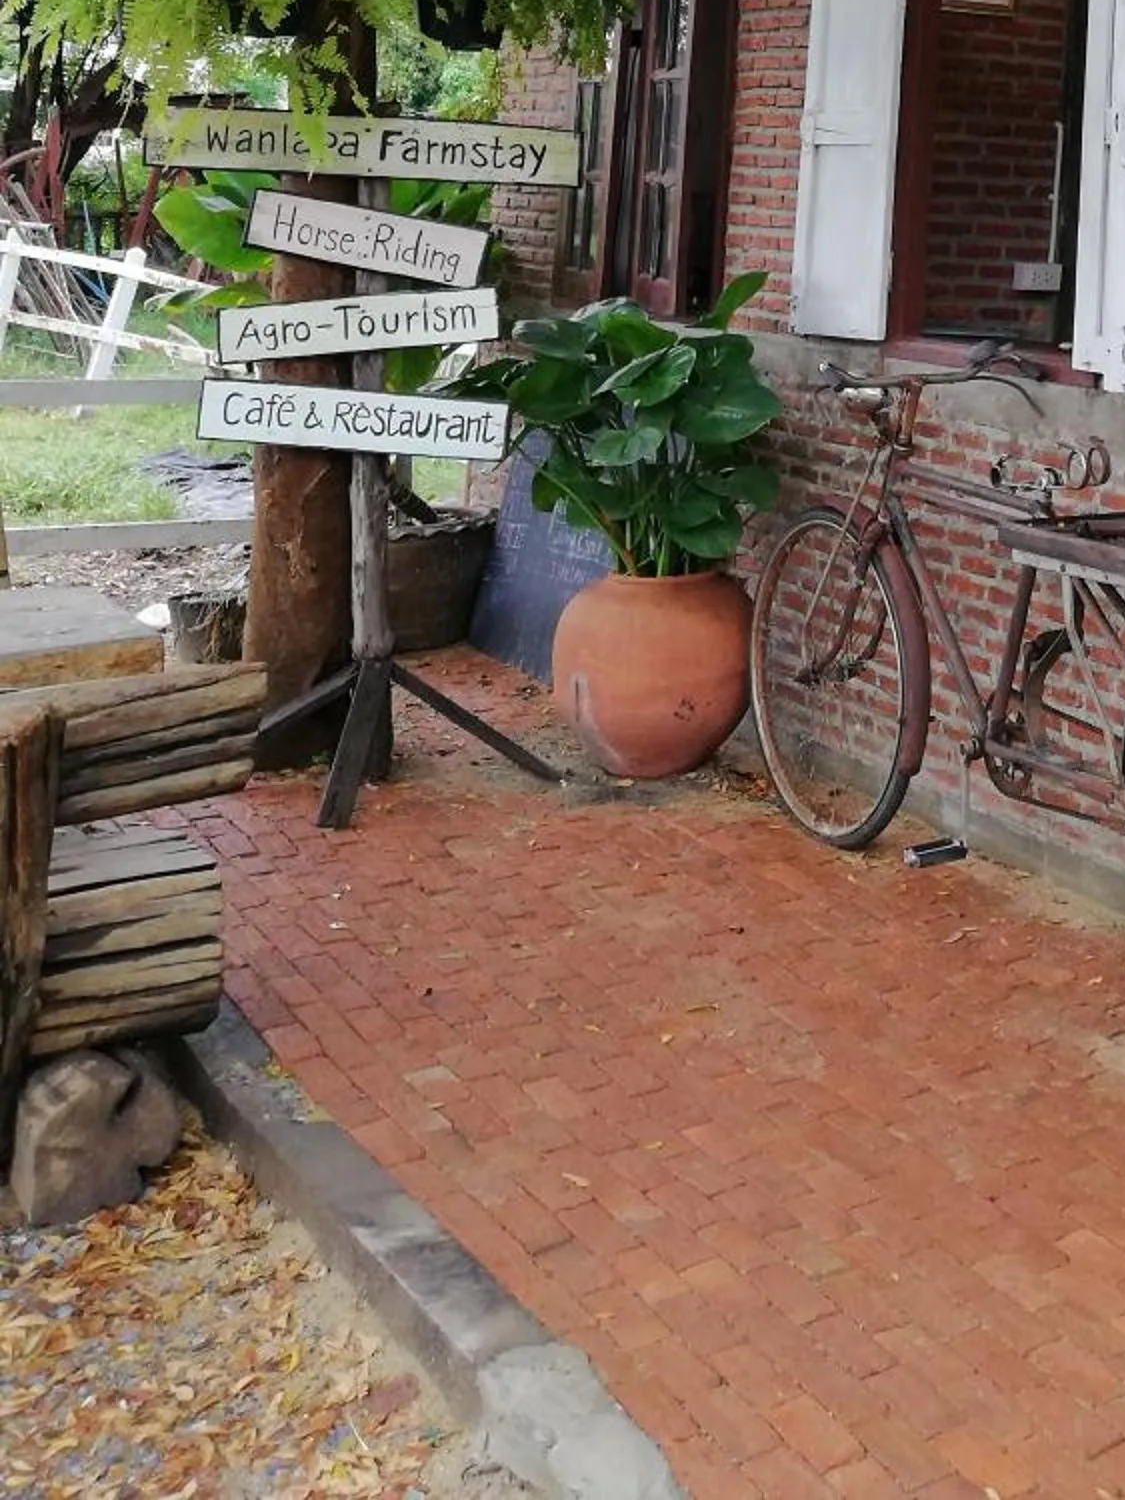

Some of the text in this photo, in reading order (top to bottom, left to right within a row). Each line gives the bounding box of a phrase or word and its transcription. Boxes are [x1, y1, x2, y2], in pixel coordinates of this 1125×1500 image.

[379, 129, 548, 178] Farmstay
[272, 203, 462, 285] Horse Riding
[222, 391, 497, 444] Café & Restaurant
